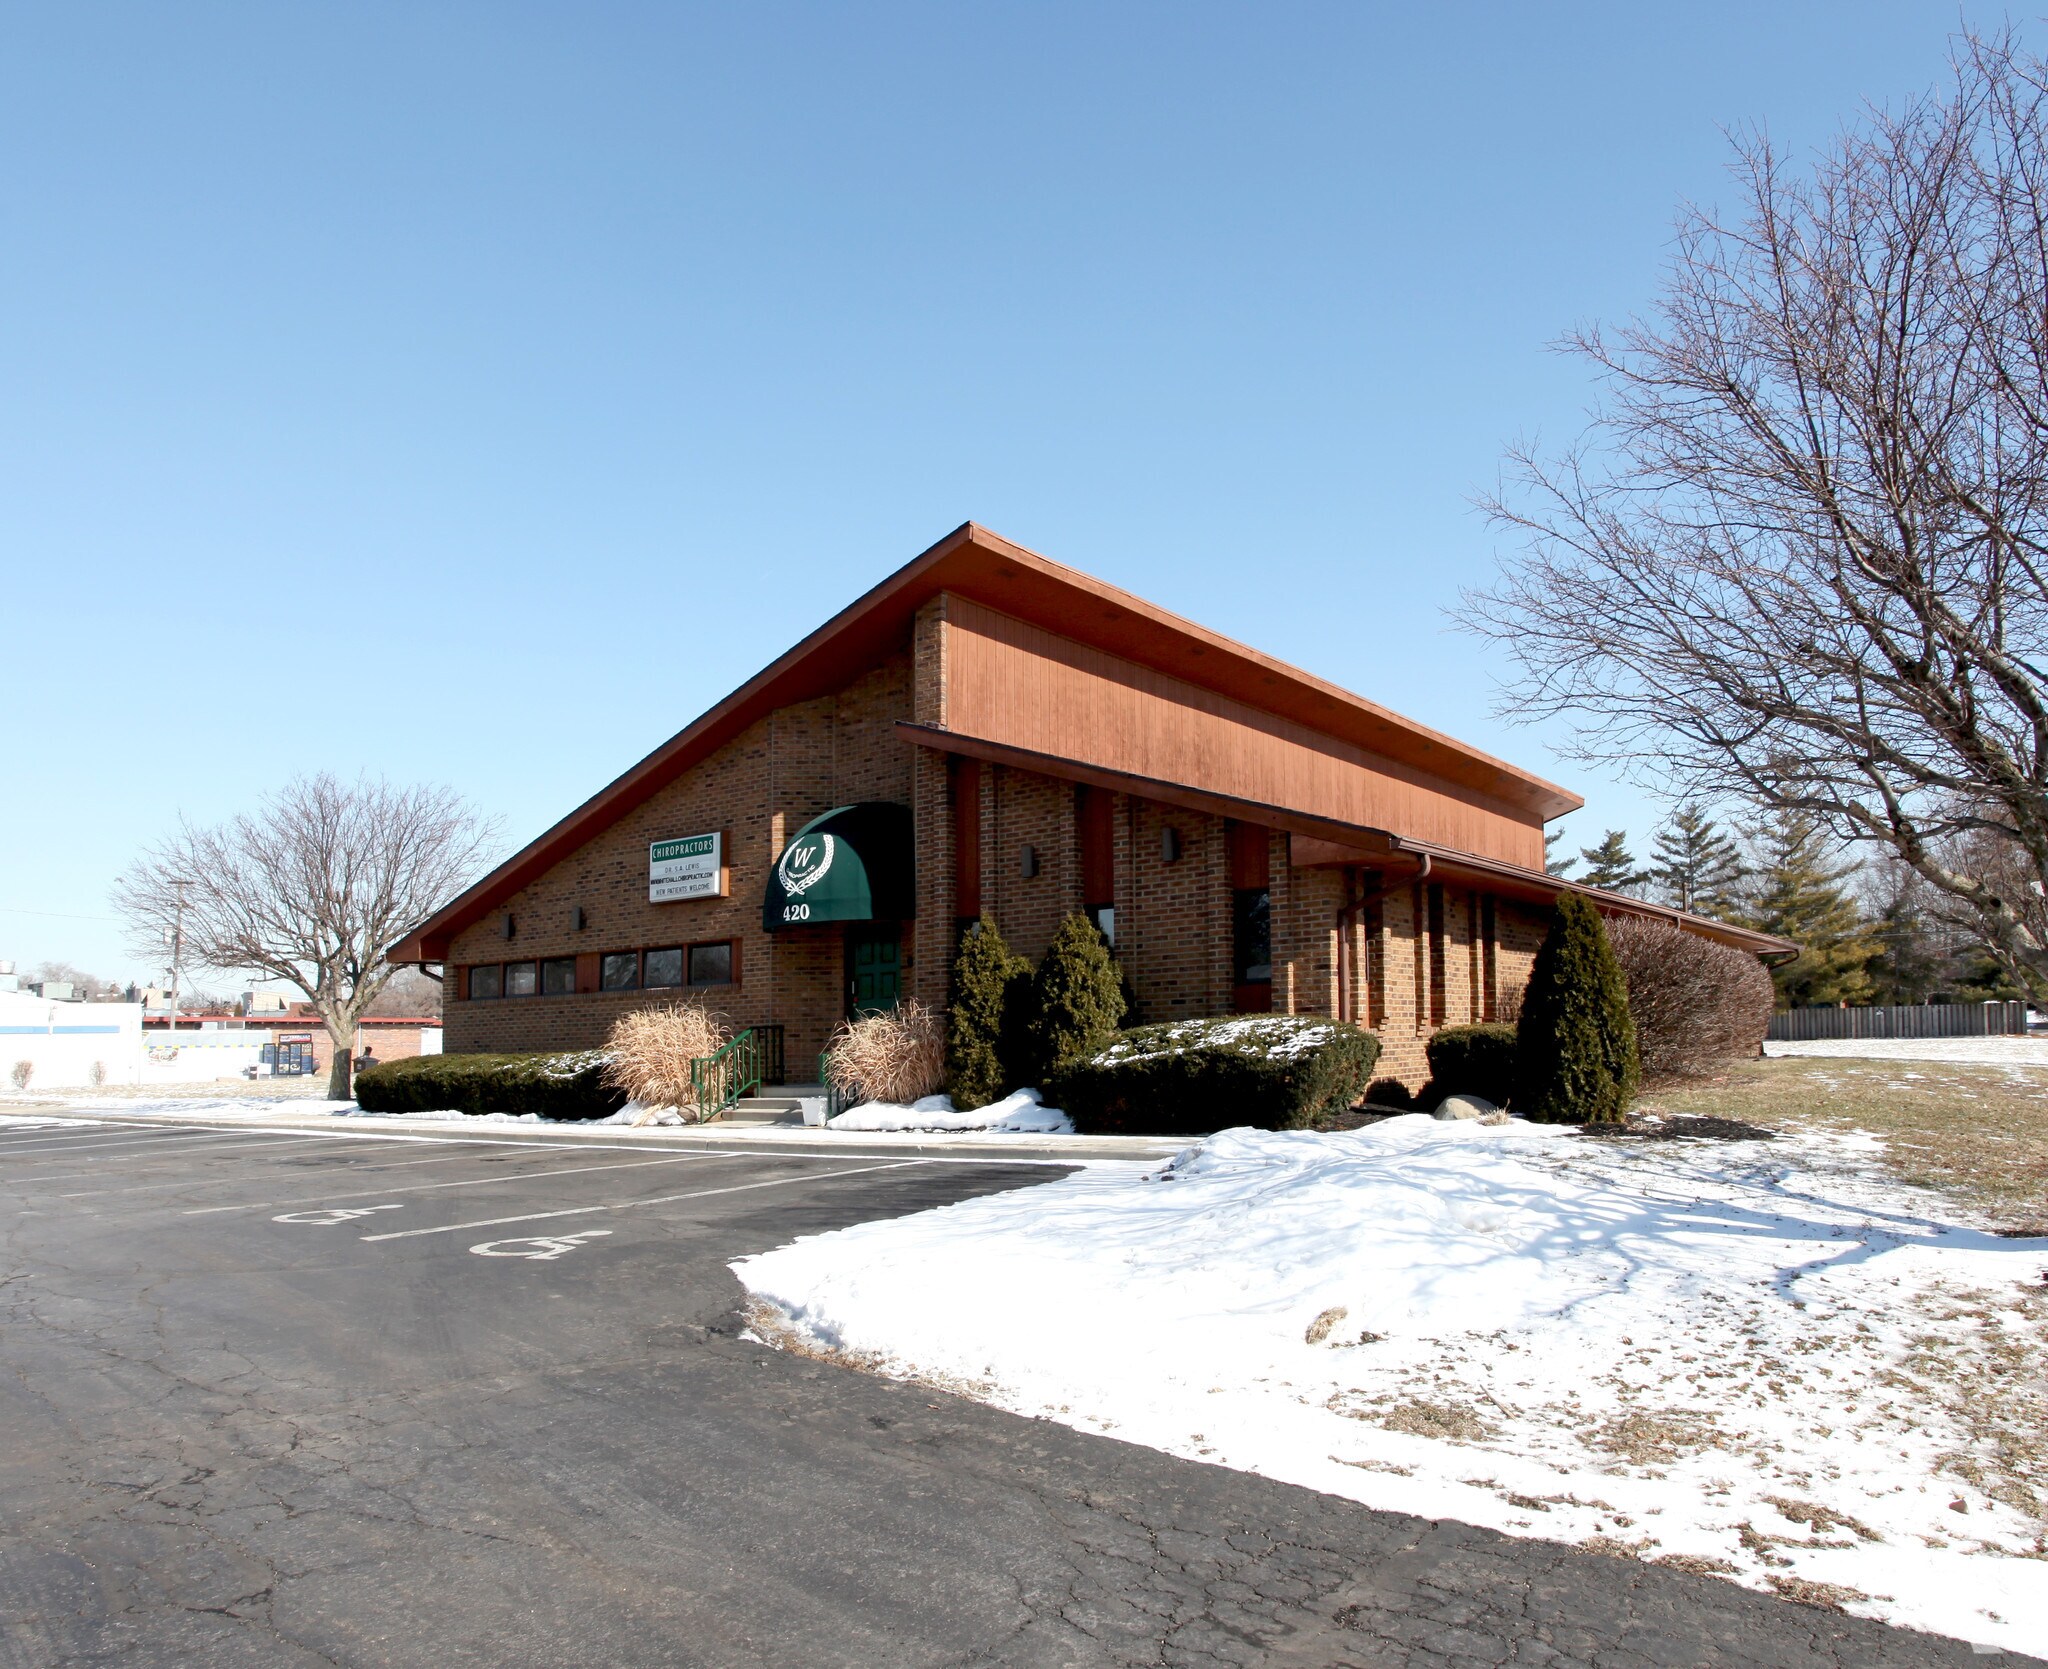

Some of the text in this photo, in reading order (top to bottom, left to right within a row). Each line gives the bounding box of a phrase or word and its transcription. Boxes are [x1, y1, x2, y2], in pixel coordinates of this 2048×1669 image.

[652, 839, 713, 859] CHIROPRACTORS
[794, 846, 817, 868] W
[685, 862, 700, 871] LEWIS
[656, 882, 710, 896] NEW PATIENTS WELCOME
[783, 903, 810, 921] 420
